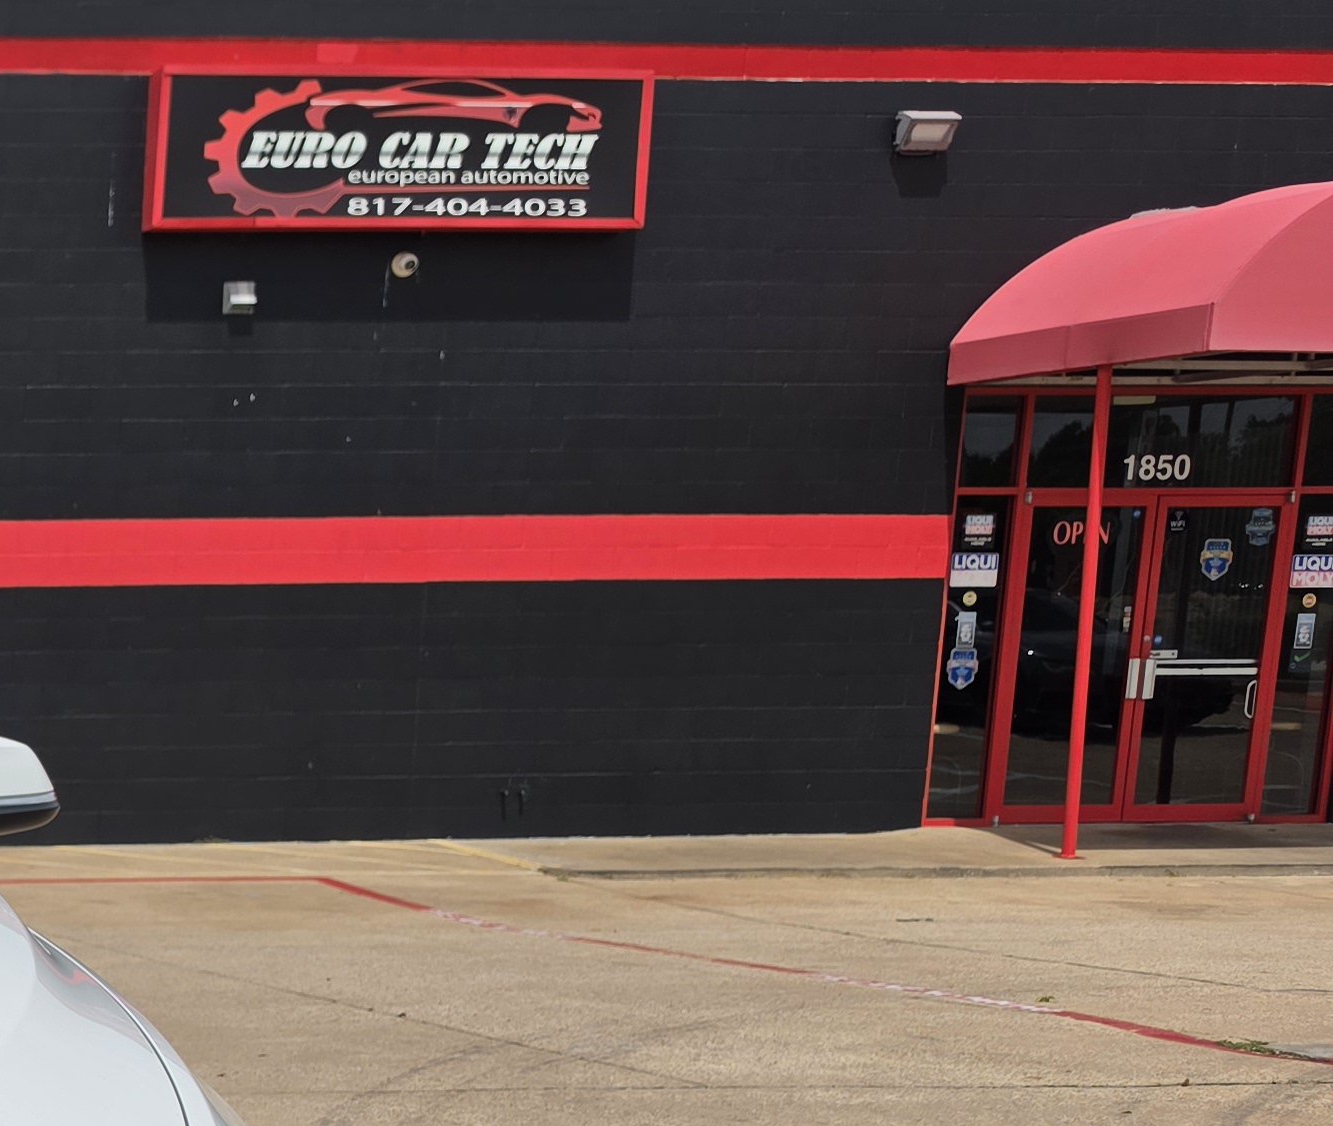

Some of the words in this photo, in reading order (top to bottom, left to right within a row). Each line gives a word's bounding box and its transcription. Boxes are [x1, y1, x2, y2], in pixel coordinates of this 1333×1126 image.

[241, 130, 367, 169] EURO
[378, 130, 470, 169] CAR
[481, 132, 599, 169] TECH
[347, 169, 456, 187] european
[460, 168, 590, 185] automotive
[347, 196, 587, 217] 817-404-4033
[1124, 454, 1191, 481] 1850
[1053, 520, 1111, 545] OPN
[954, 554, 996, 570] LIQUI
